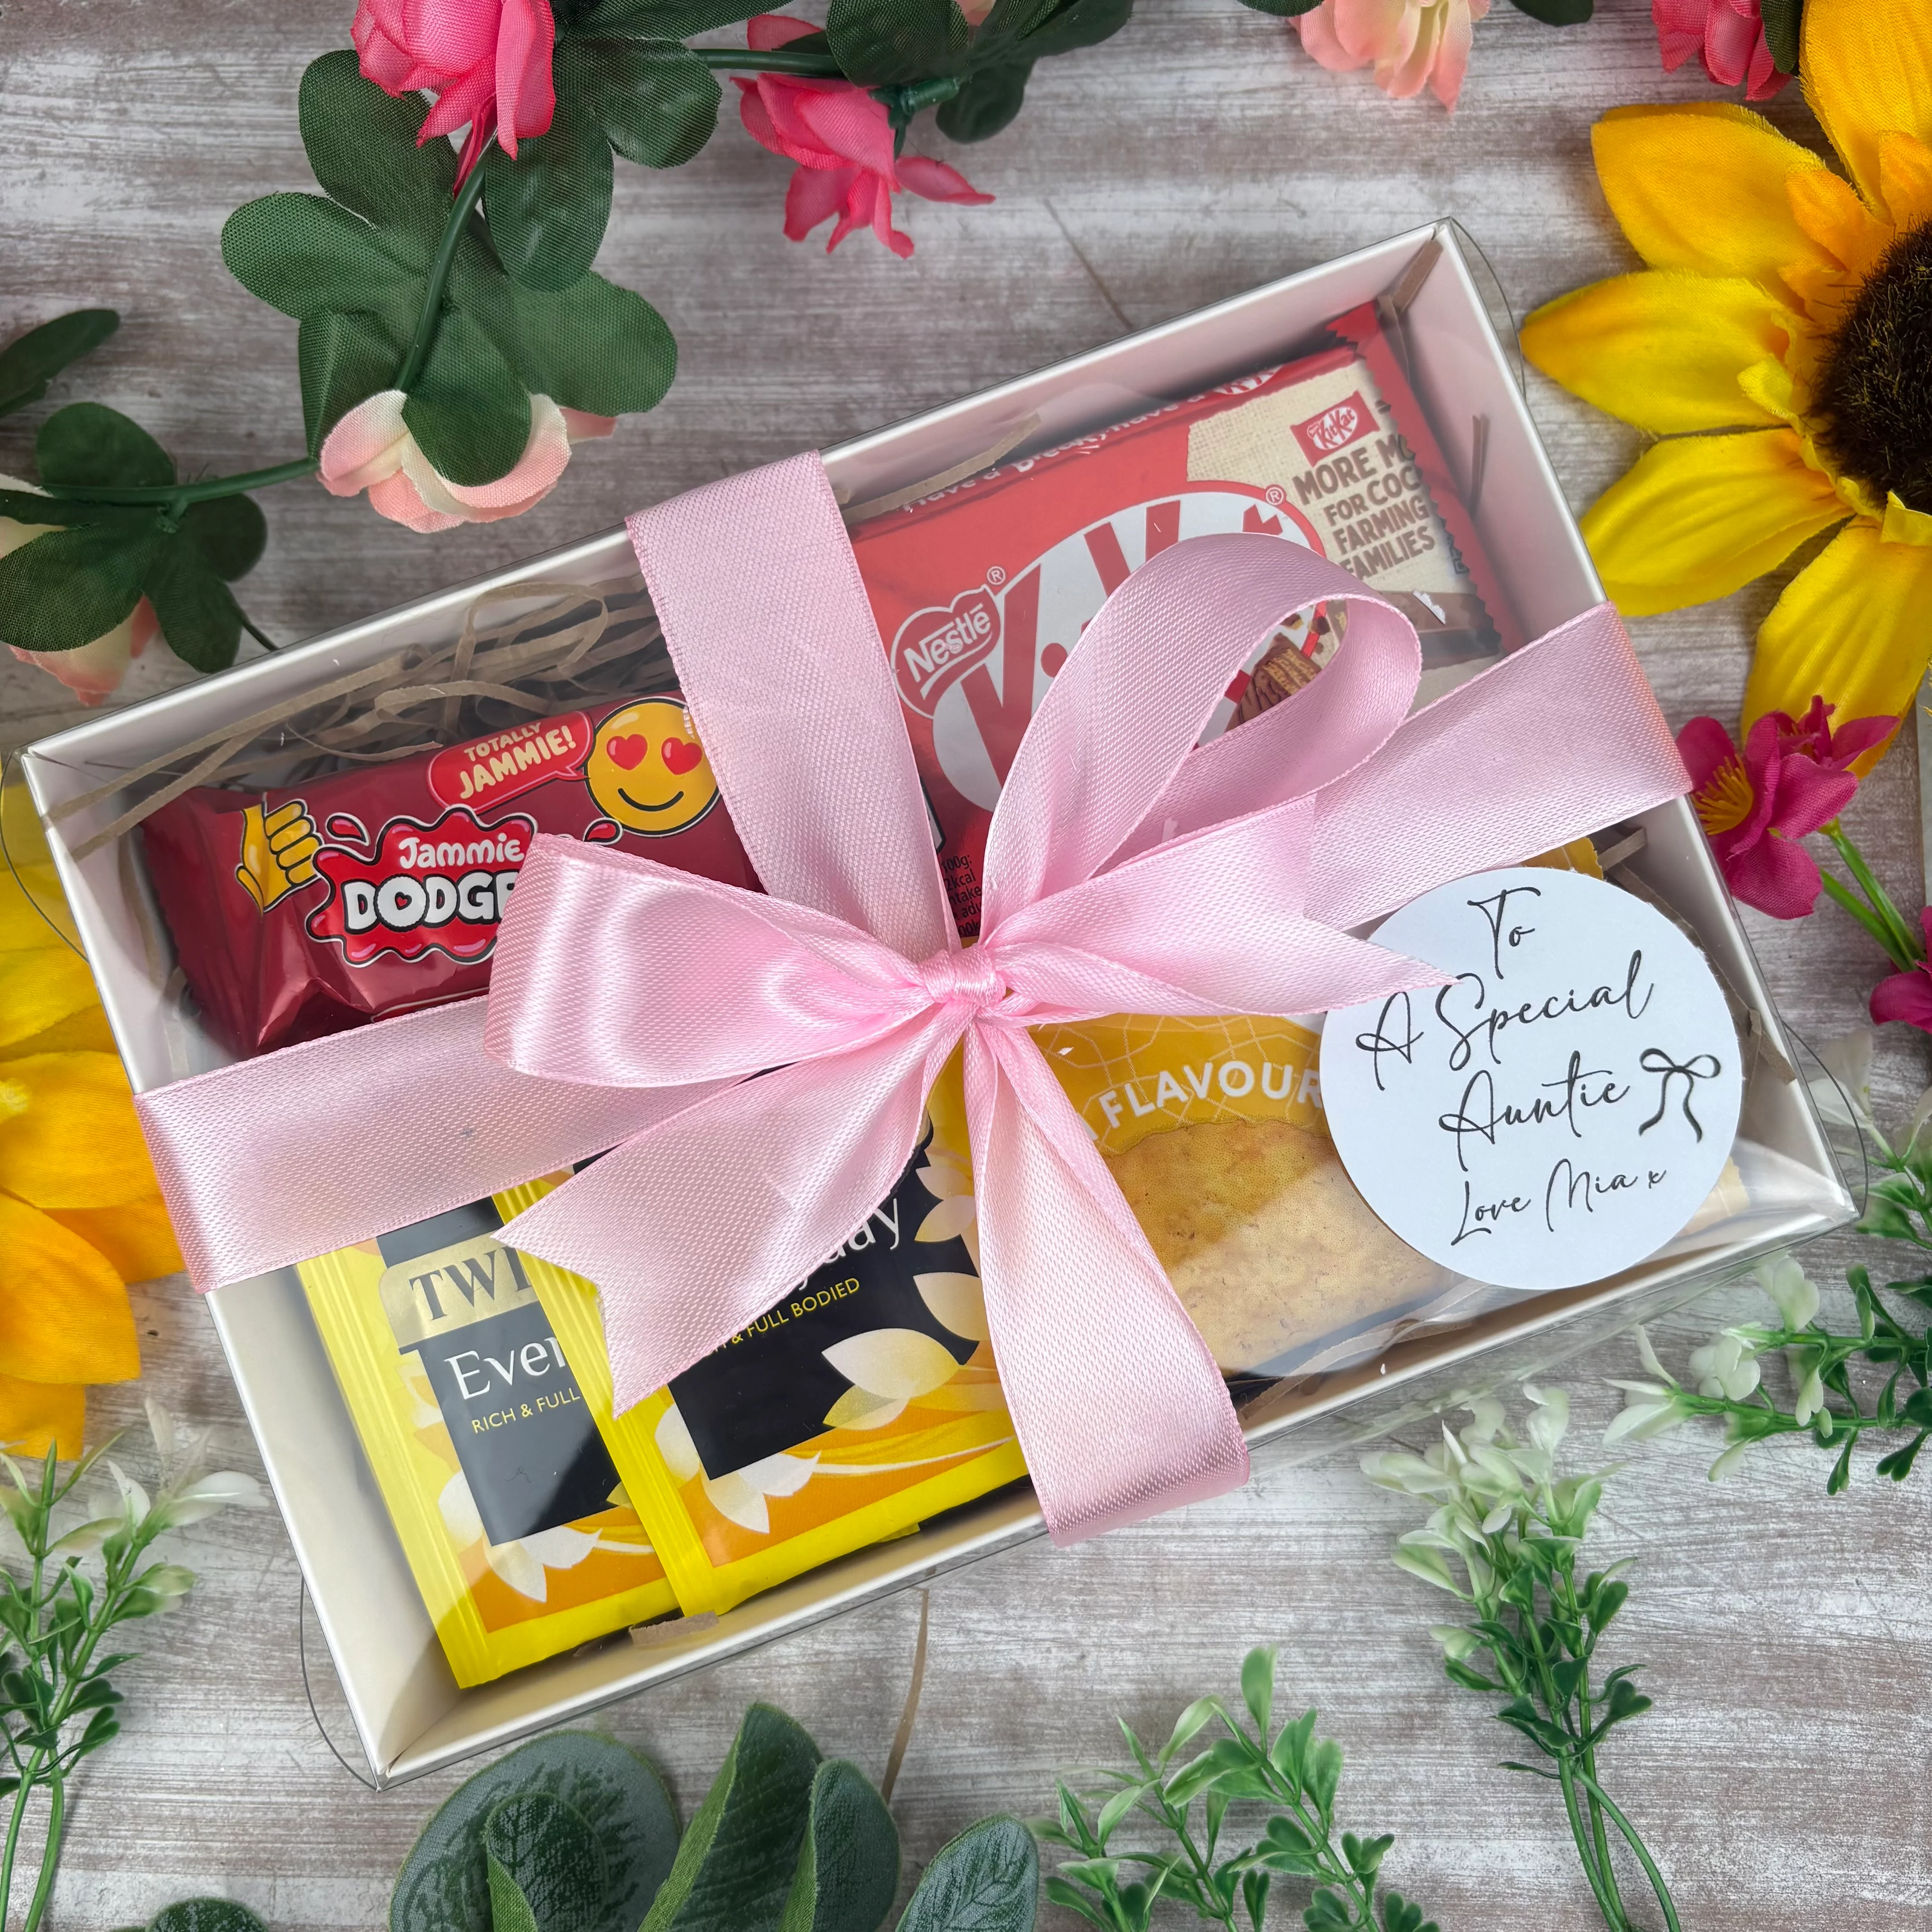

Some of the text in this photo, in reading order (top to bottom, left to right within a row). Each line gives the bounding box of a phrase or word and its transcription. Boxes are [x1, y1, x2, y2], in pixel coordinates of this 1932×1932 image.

[1292, 447, 1377, 506] MORE
[1323, 493, 1369, 527] FOR
[1332, 495, 1430, 555] FARMING
[1339, 526, 1435, 580] FAMILIES
[903, 603, 991, 683] Nestlé
[460, 725, 576, 799] JAMMIE!
[464, 722, 541, 761] TOTALLY
[399, 833, 524, 869] Jammie
[1467, 887, 1541, 980] To
[1356, 950, 1654, 1091] A Special
[1098, 1061, 1323, 1128] FLAVOUR
[1439, 1050, 1630, 1172] Auntie
[1451, 1159, 1667, 1246] Love Mia x
[746, 1310, 789, 1337] FULL
[790, 1277, 860, 1318] BODIED
[471, 1387, 581, 1434] RICH & FULL
